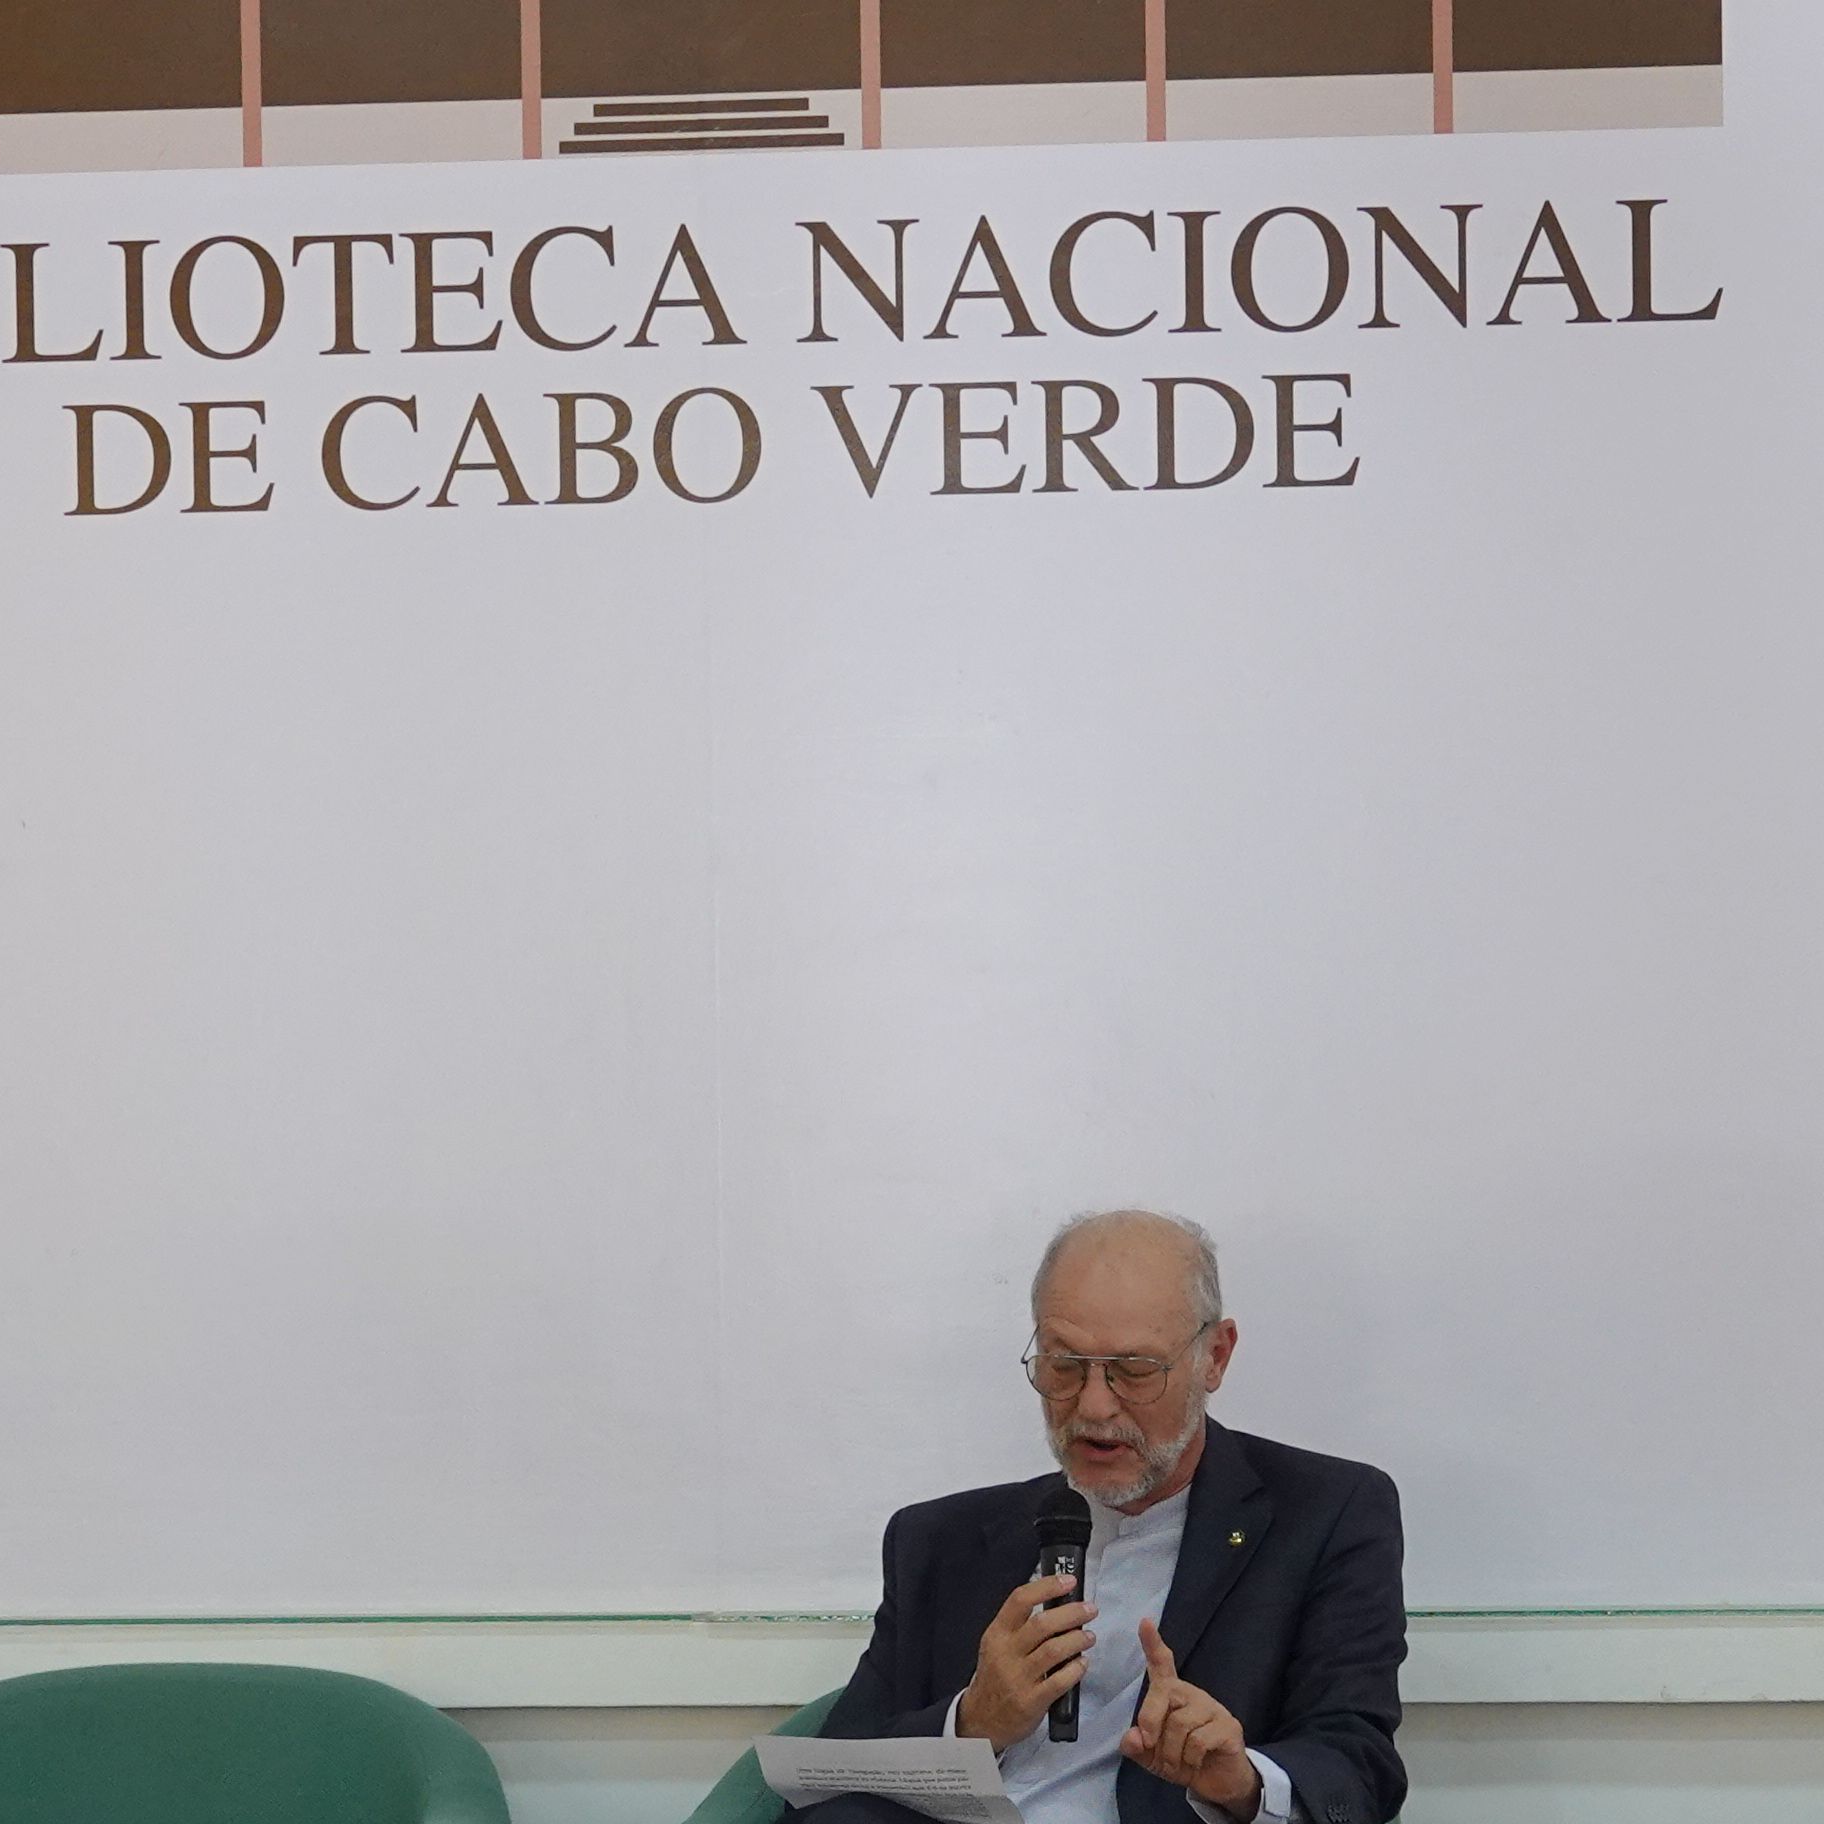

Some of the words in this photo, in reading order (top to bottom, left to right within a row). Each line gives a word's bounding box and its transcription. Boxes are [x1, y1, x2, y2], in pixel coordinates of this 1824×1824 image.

[795, 198, 1724, 343] NACIONAL
[62, 400, 275, 516] DE
[321, 387, 762, 511] CABO
[810, 373, 1361, 499] VERDE
